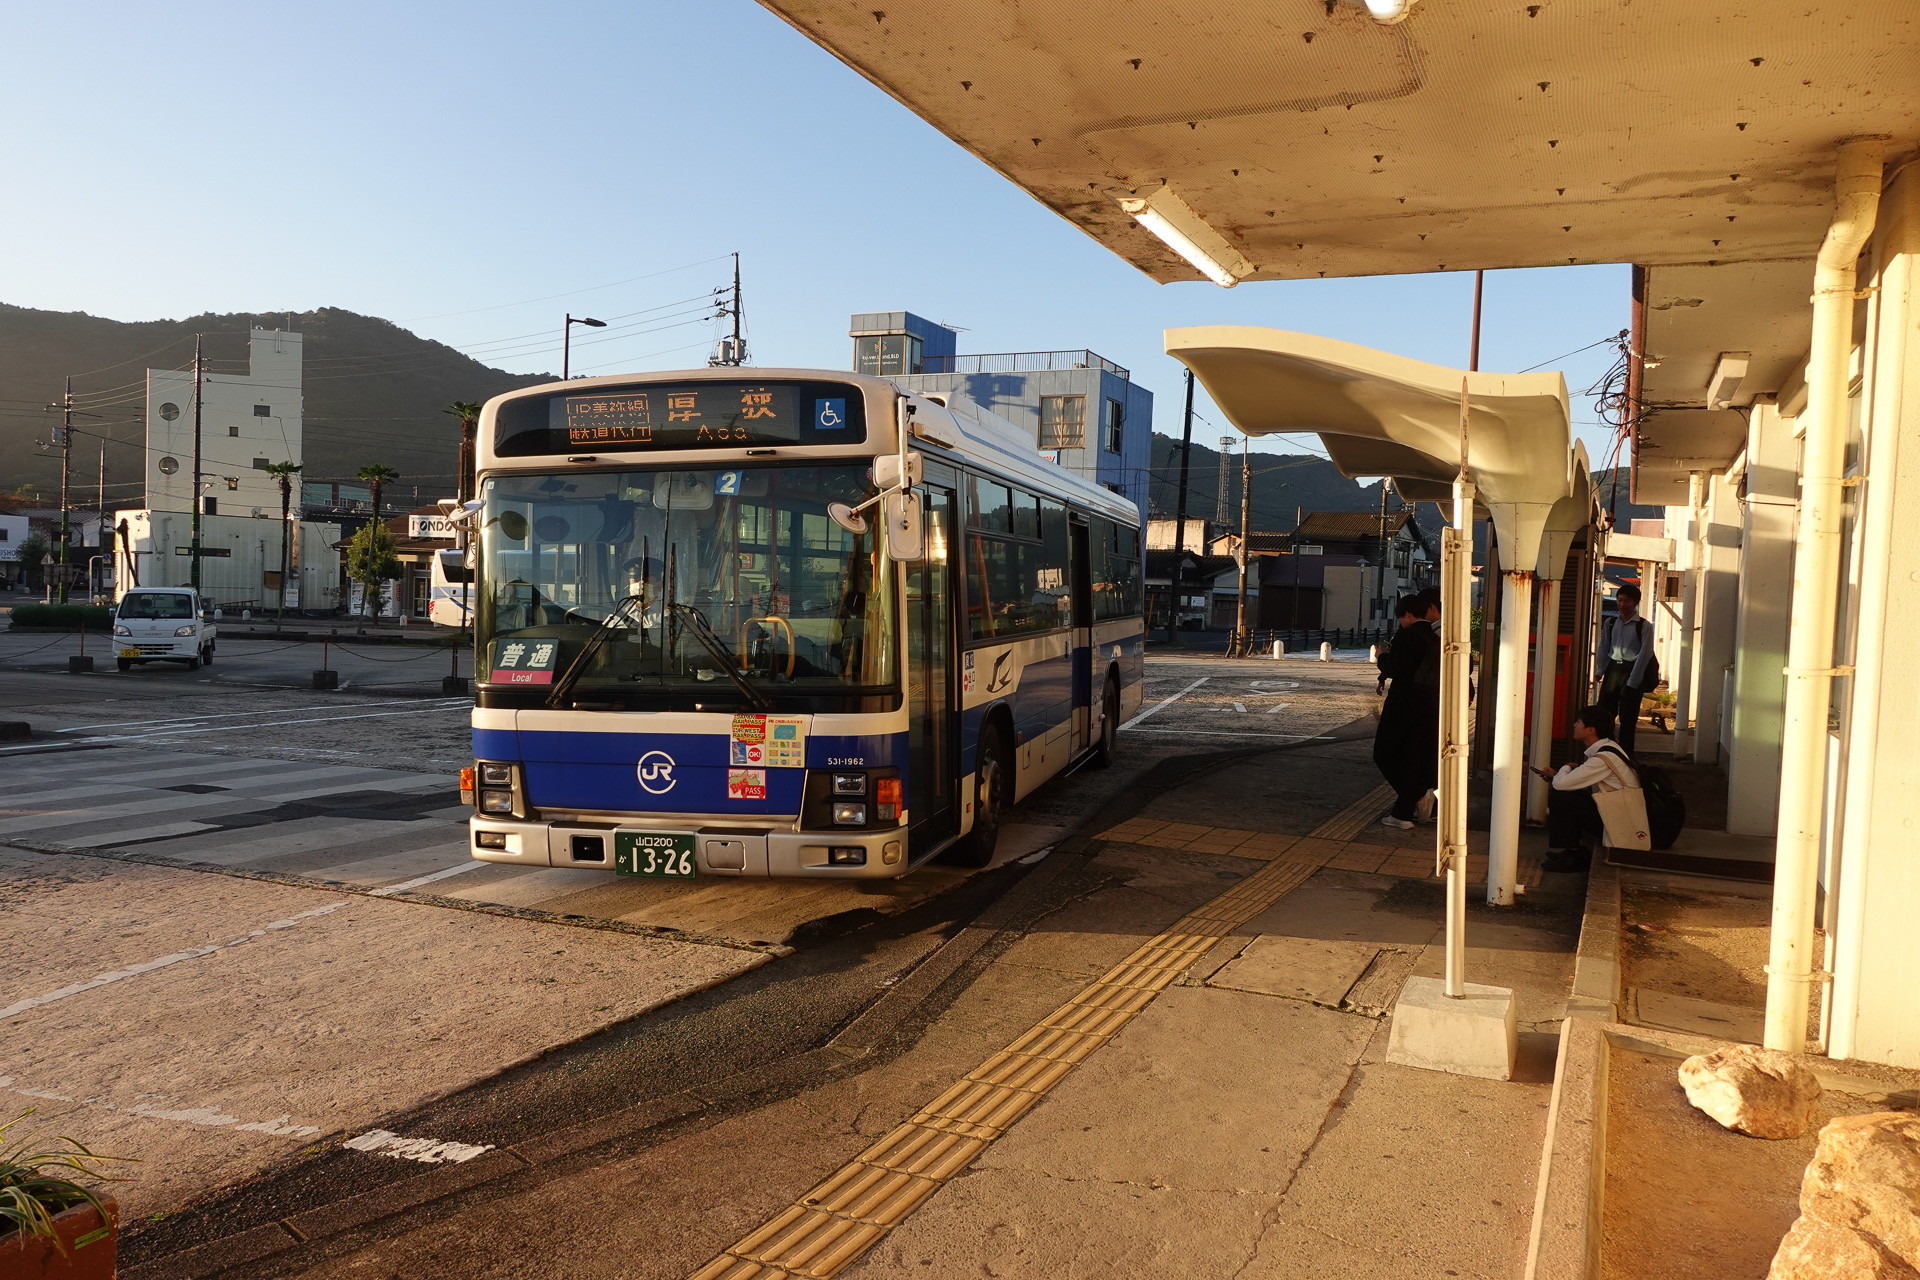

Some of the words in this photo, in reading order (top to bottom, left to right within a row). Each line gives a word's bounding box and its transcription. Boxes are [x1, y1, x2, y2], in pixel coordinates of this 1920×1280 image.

[720, 471, 737, 494] 2
[500, 643, 554, 668] 普通
[512, 673, 532, 682] Local
[828, 757, 864, 766] 531-1962
[745, 787, 761, 795] PASS
[632, 847, 692, 875] 13-26
